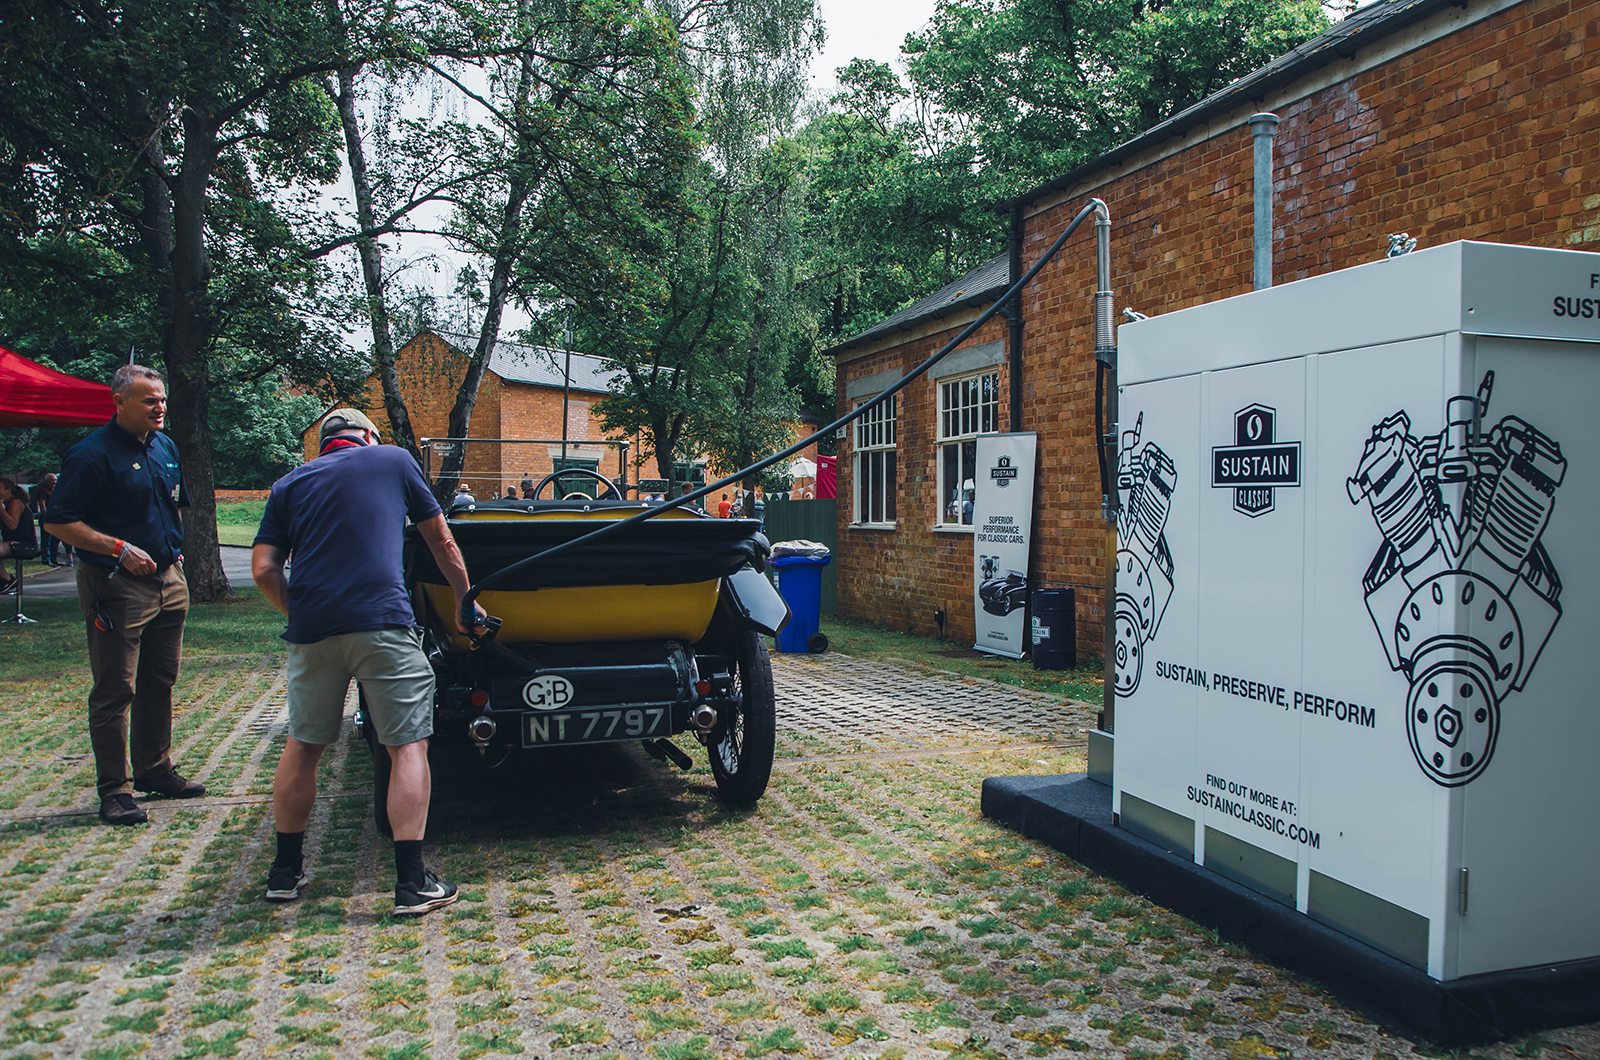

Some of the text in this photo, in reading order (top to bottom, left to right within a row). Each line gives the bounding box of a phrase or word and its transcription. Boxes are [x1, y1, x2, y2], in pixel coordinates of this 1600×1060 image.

[1590, 273, 1600, 289] F
[992, 469, 1015, 477] SUSTAIN
[1221, 455, 1290, 477] SUSTAIN
[1239, 490, 1270, 508] CLASSIC
[988, 516, 1014, 525] SUPERIOR
[977, 533, 1026, 545] FOR CLASSIC CARS.
[982, 525, 1020, 535] PERFORMANCE
[1156, 660, 1376, 729] SUSTAIN, PRESERVE, PERFORM
[529, 707, 664, 743] NT 7797
[1206, 773, 1297, 817] FIND OUT MORE AT:
[1187, 785, 1320, 850] SUSTAINCLASSIC.COM
